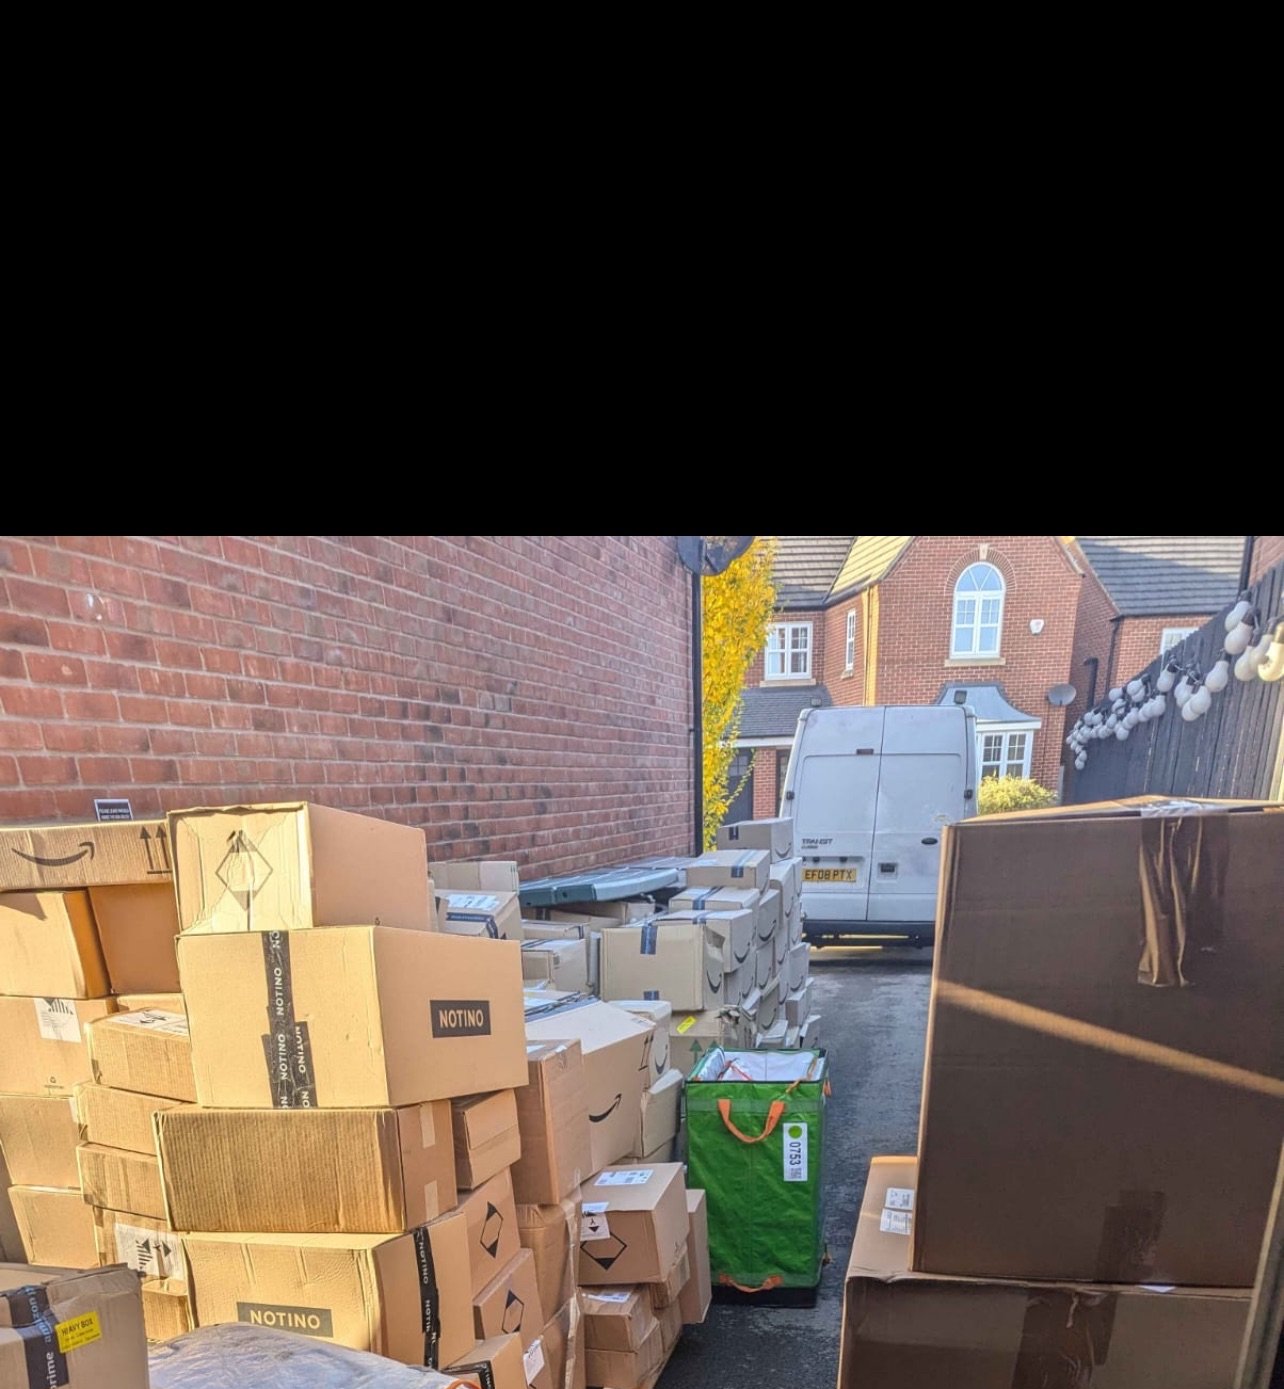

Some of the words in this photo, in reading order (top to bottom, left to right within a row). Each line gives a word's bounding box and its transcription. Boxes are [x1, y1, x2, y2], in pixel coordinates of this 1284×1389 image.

[805, 869, 831, 881] EF08
[273, 967, 284, 1016] NOTINO
[439, 1009, 484, 1028] NOTINO
[278, 1034, 288, 1080] NOTINO
[789, 1142, 801, 1166] 0753
[418, 1242, 429, 1285] NOTINO
[250, 1309, 321, 1330] NOTINO
